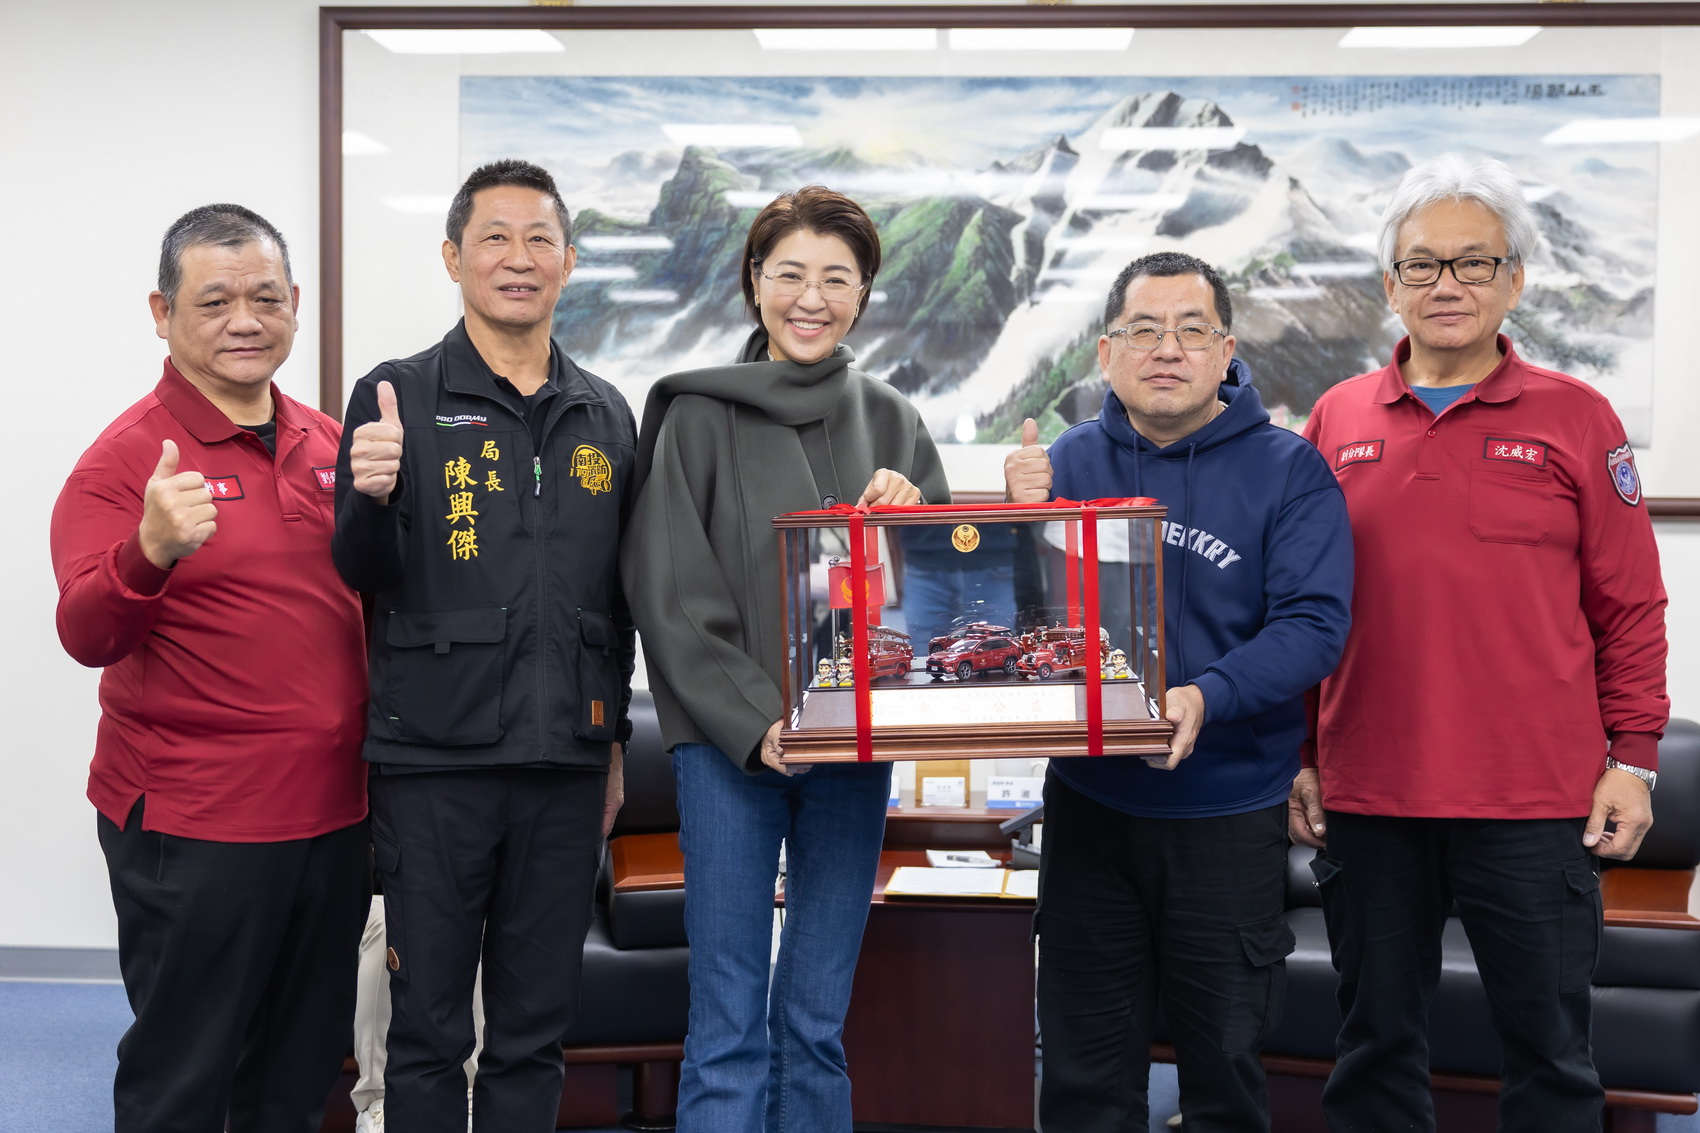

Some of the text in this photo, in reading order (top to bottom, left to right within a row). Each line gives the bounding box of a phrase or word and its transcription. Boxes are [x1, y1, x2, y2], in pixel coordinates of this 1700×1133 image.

[480, 440, 505, 492] 局長
[1494, 444, 1538, 462] 沈威宏
[444, 456, 479, 561] 陳興傑
